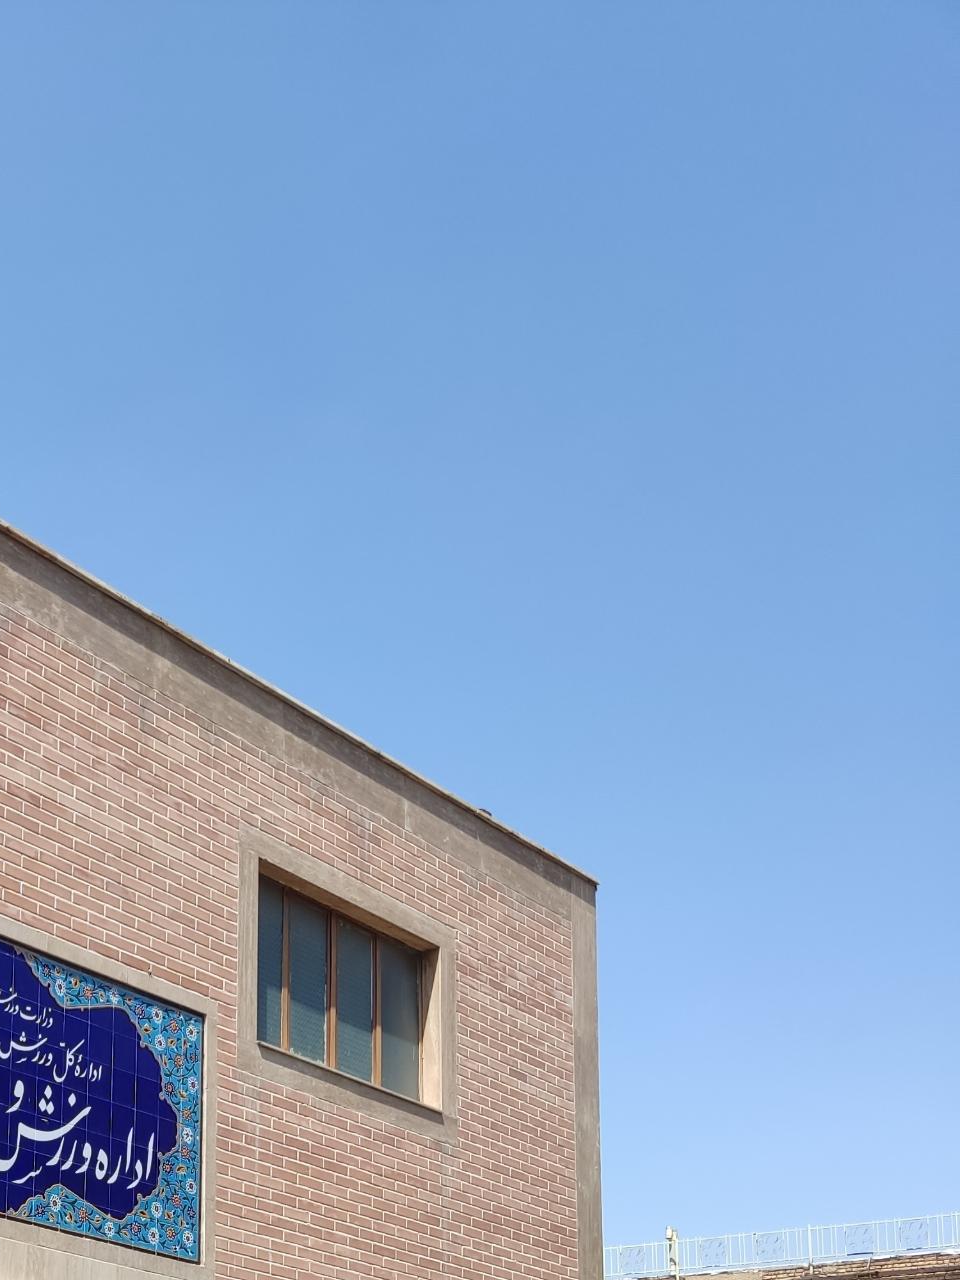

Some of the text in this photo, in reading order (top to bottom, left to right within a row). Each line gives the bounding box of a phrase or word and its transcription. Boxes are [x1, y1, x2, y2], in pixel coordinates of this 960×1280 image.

[19, 1006, 54, 1029] وزارت
[5, 1078, 25, 1114] و
[94, 1127, 156, 1190] اداره
